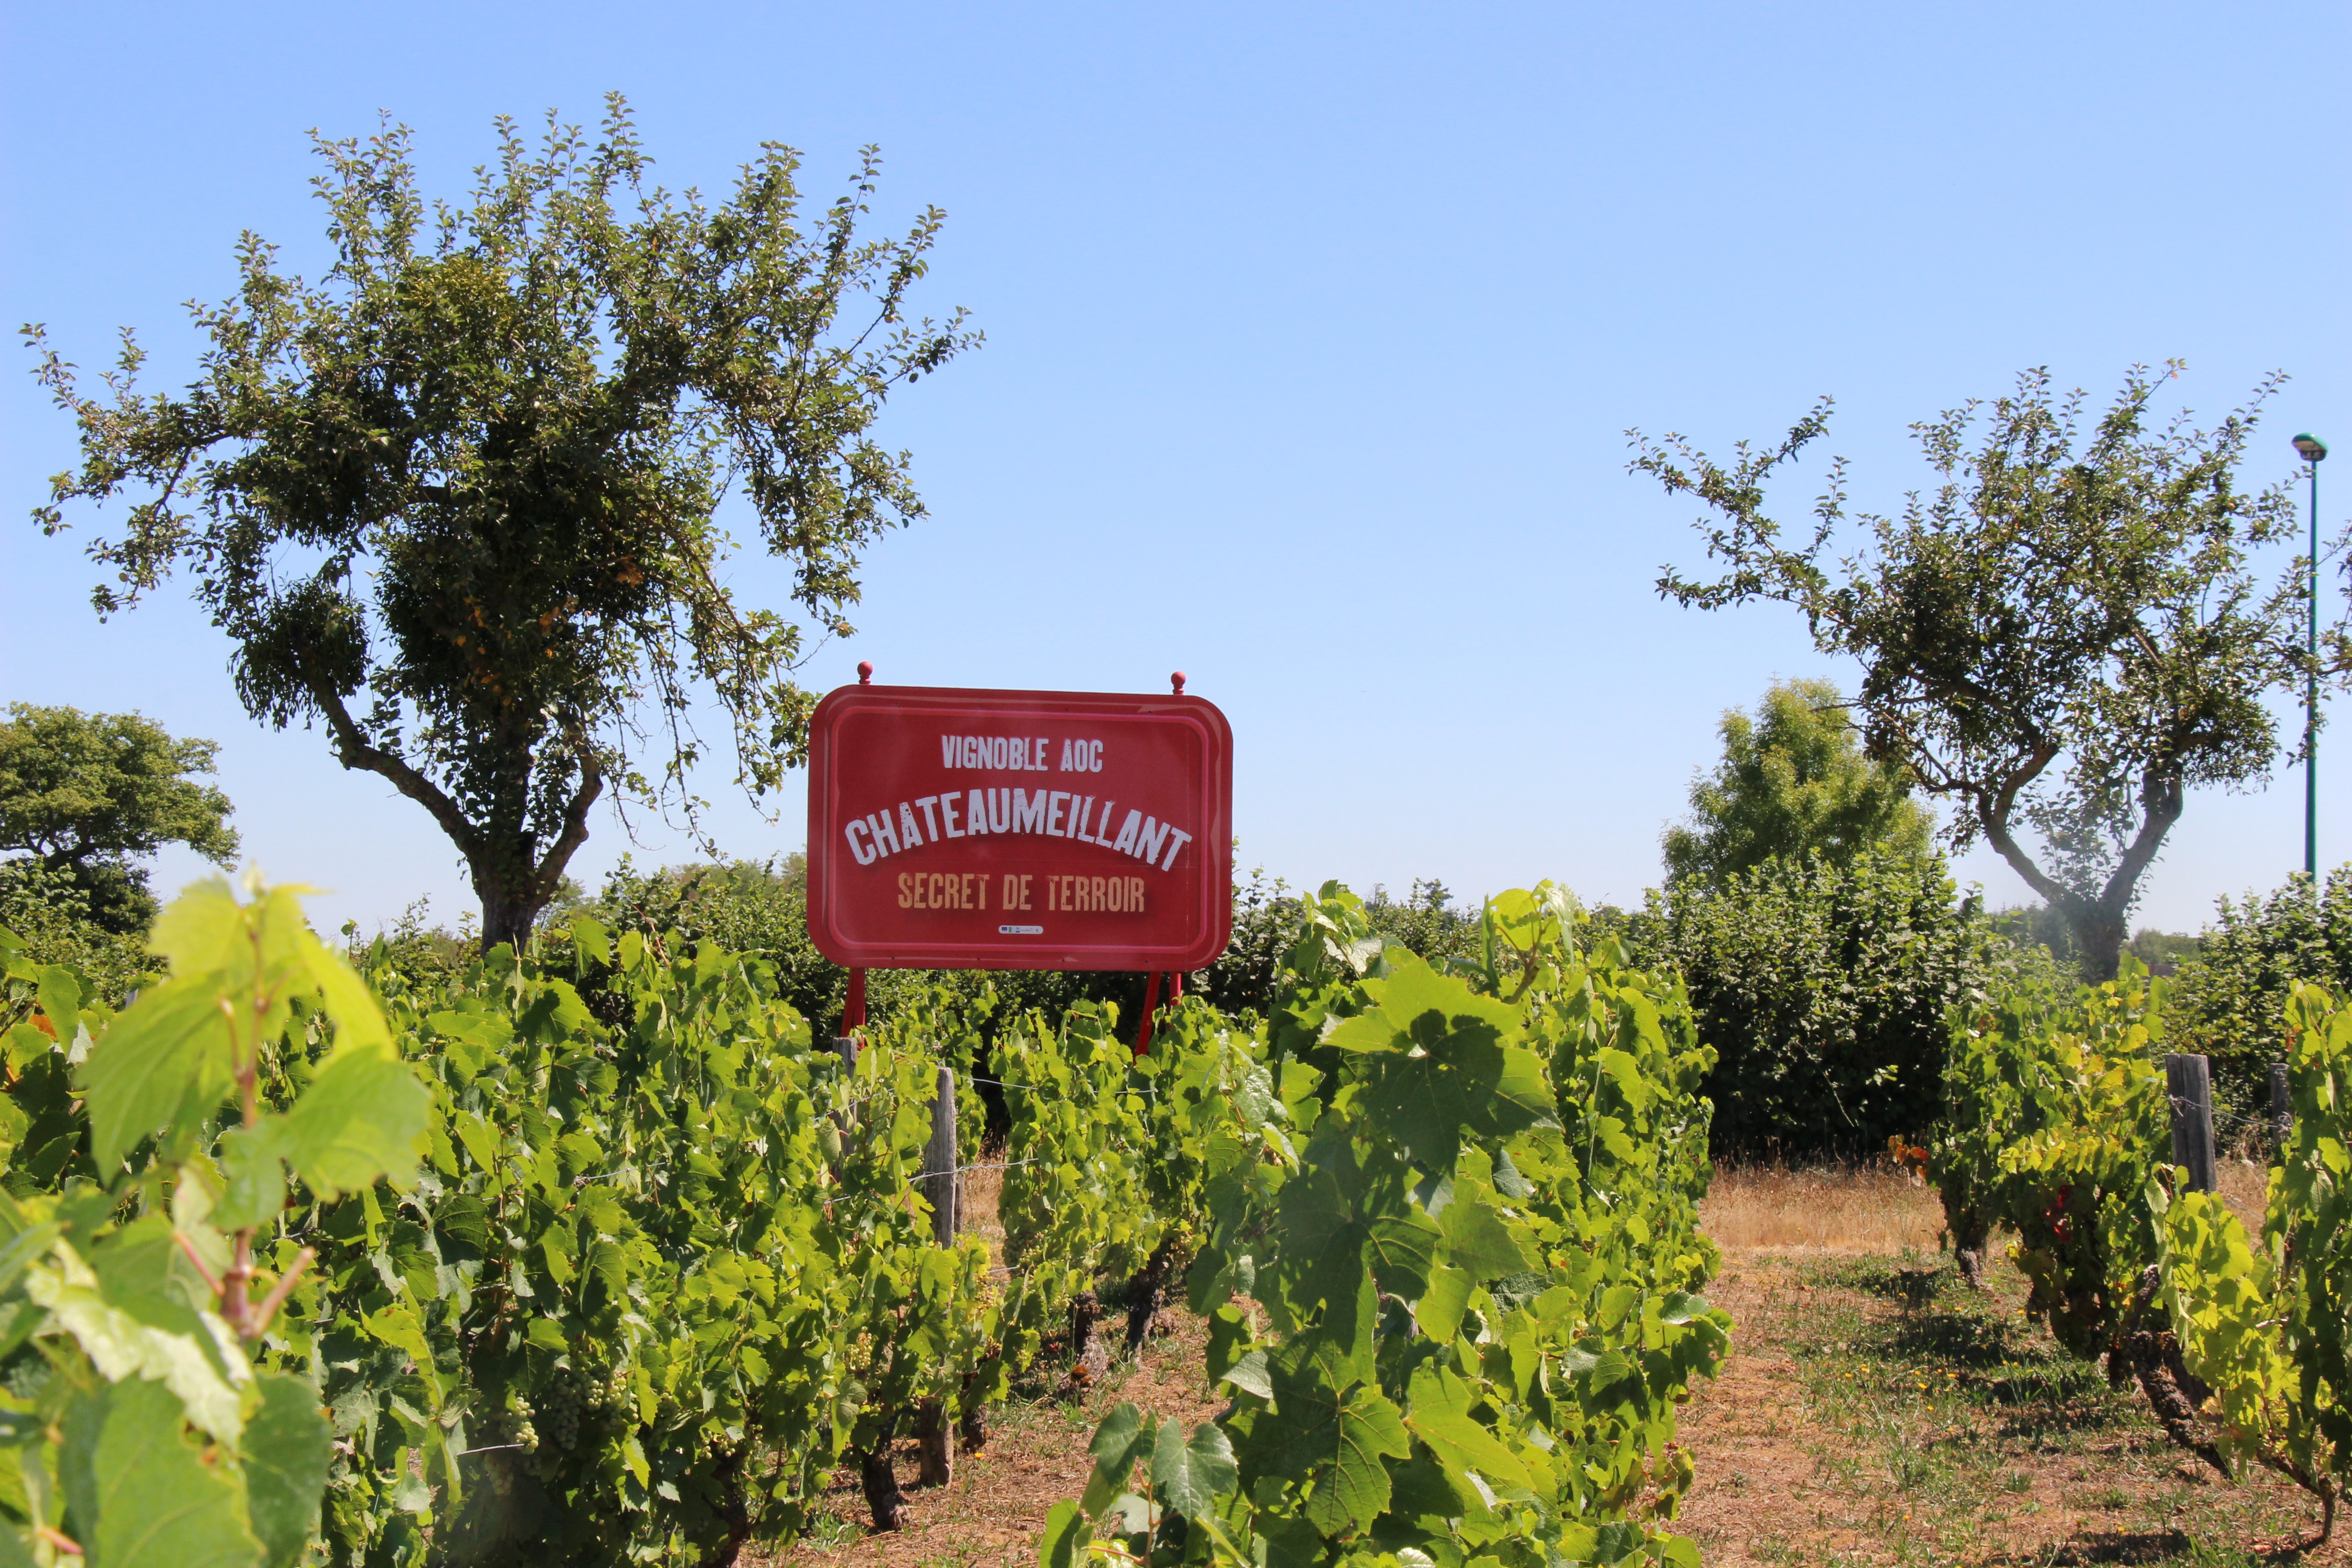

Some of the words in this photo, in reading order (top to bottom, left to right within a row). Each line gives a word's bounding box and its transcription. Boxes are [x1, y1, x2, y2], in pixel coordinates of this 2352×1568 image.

[942, 735, 1049, 771] VIGNOBLE
[1061, 739, 1103, 773] AOC
[845, 788, 1192, 871] CHATEAUMEILLANT
[898, 872, 990, 909] SECRET
[1003, 875, 1032, 910] DE
[1047, 875, 1145, 912] TERROIR
